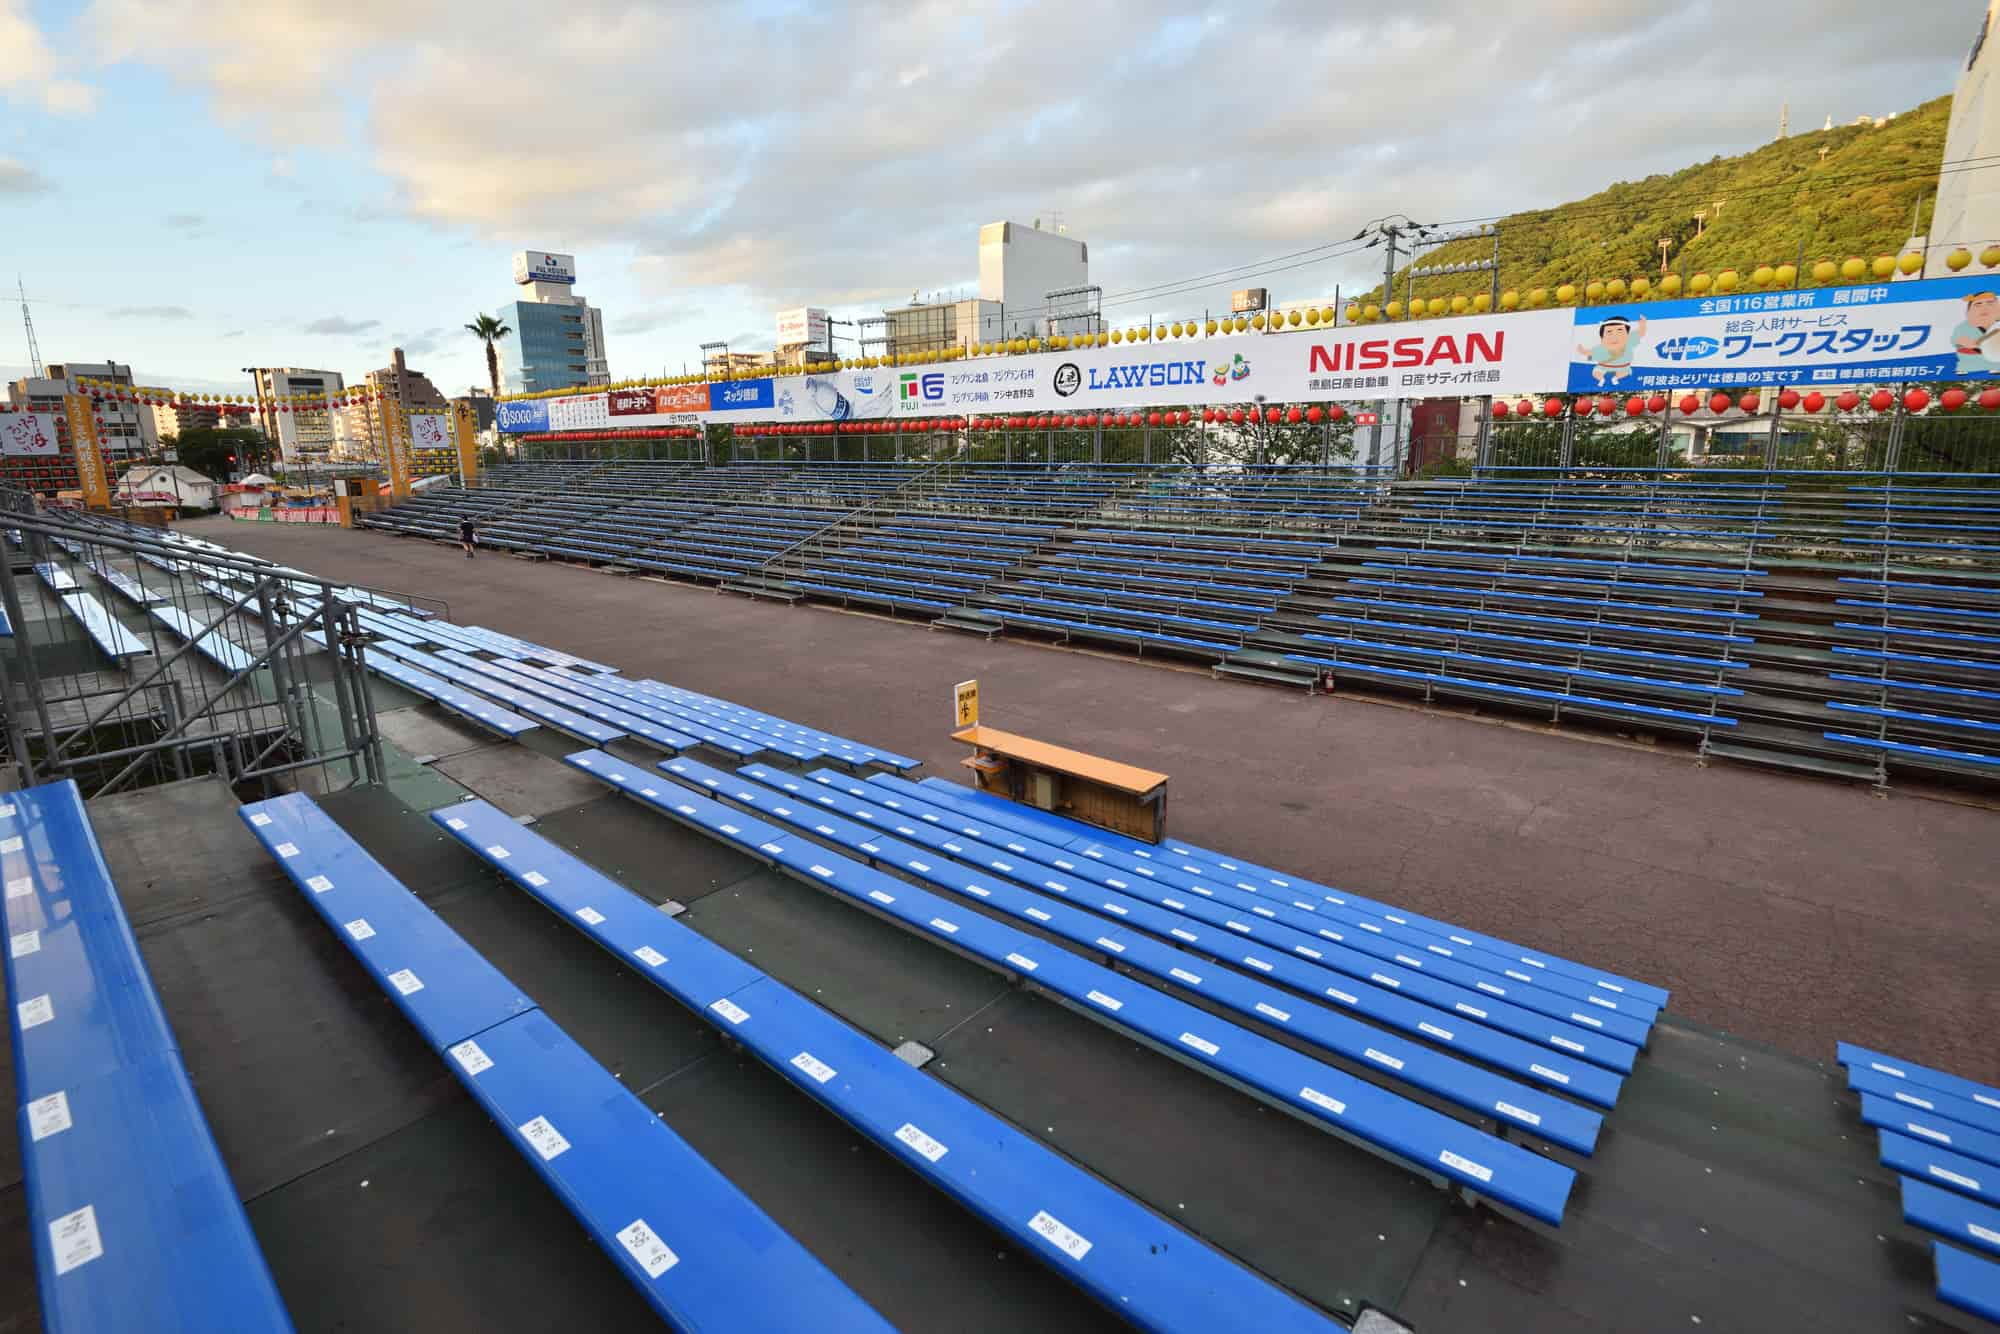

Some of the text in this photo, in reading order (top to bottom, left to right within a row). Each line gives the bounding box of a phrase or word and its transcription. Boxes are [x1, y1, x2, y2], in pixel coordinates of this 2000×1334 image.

[1700, 288, 1888, 313] 全国116営業所 展開中
[1725, 314, 1848, 334] 総合人財サービス
[1309, 331, 1505, 373] NISSAN
[1723, 325, 1931, 359] ワークスタッフ
[1088, 361, 1206, 390] LAWSON
[1309, 369, 1501, 391] 徳島日産自動車 日産サティオ徳島
[510, 409, 531, 424] SOGO
[900, 401, 919, 411] FUJI
[677, 414, 699, 424] TOYOTA
